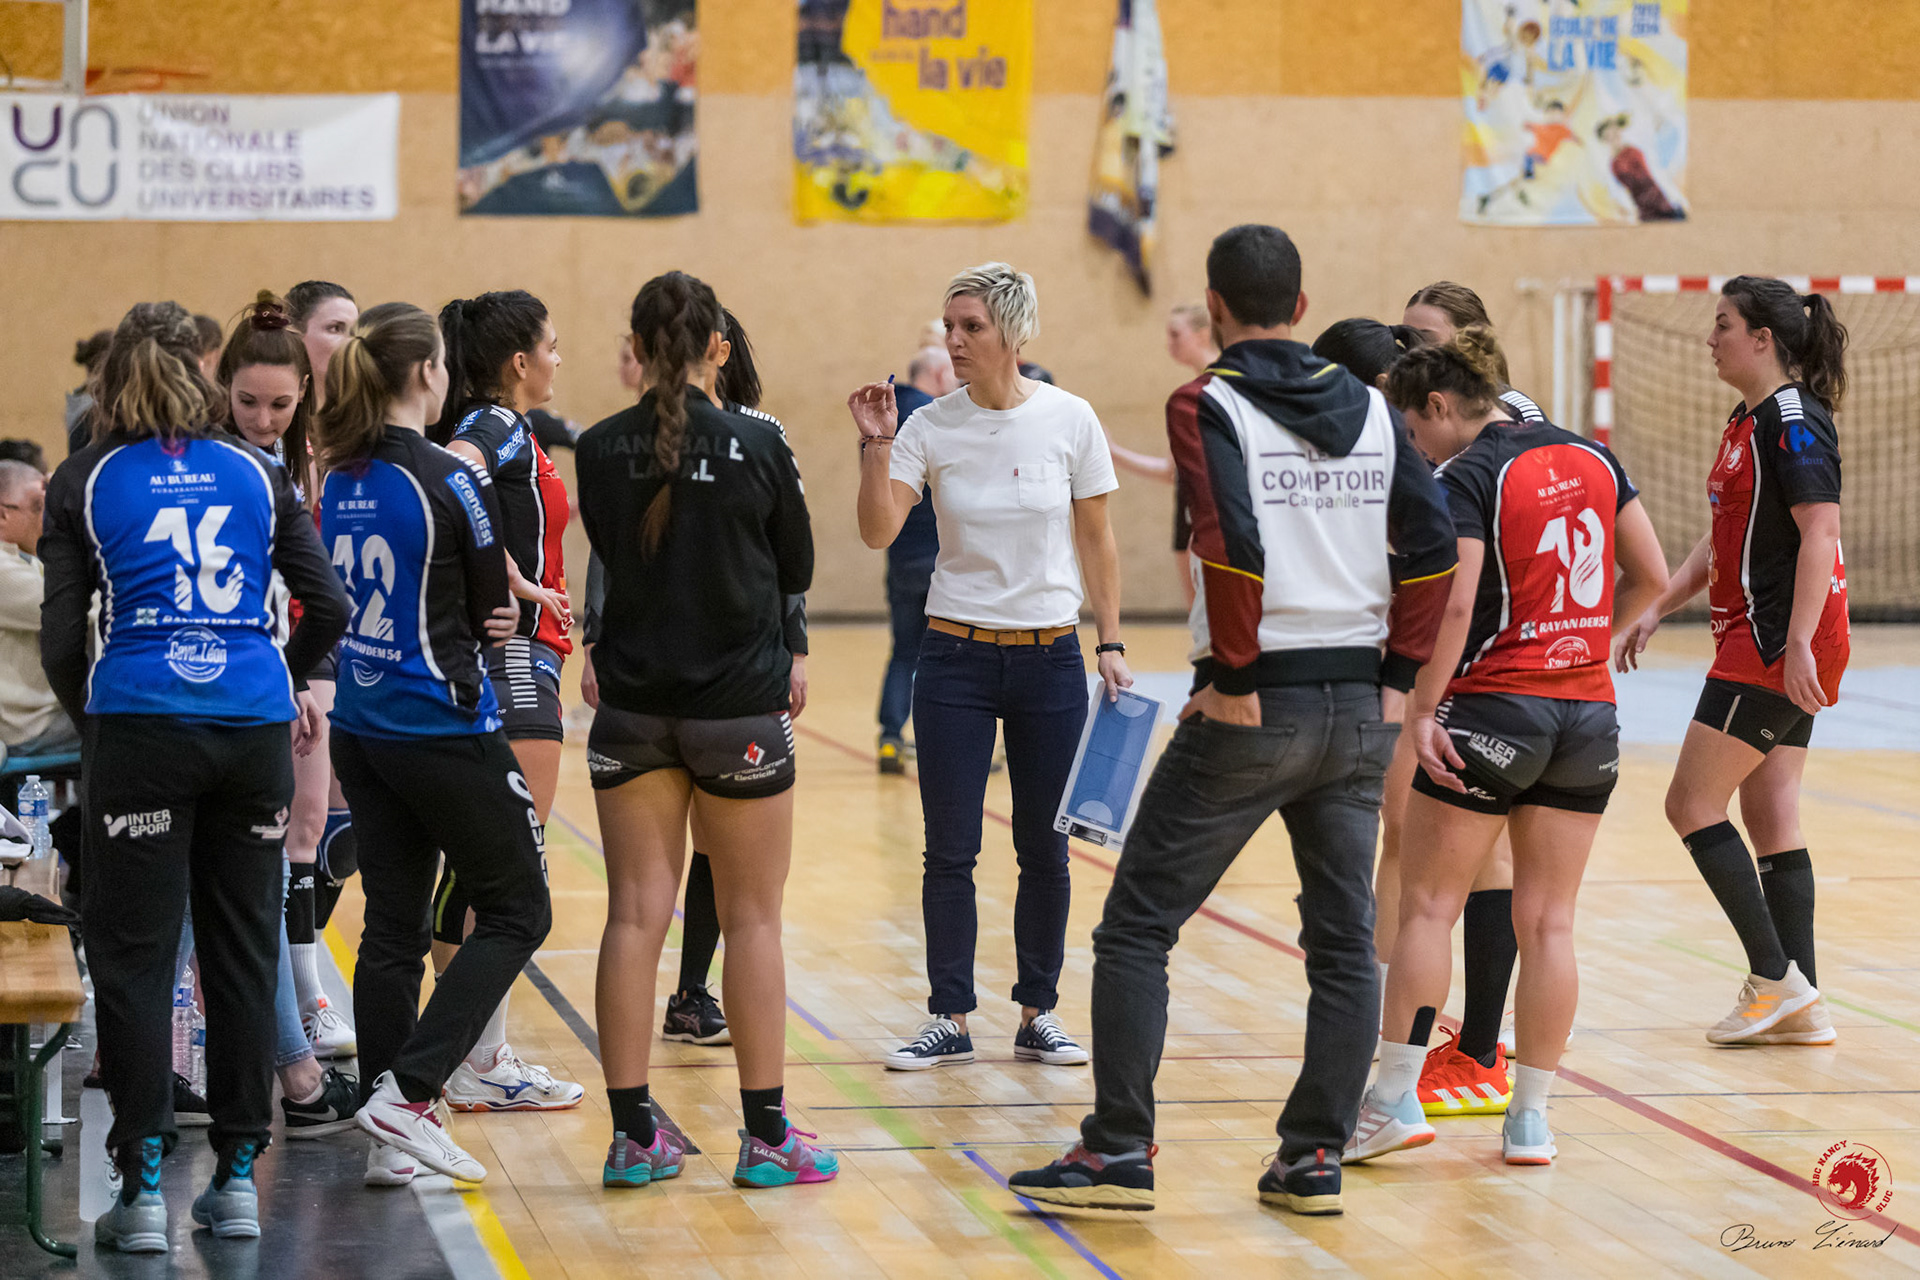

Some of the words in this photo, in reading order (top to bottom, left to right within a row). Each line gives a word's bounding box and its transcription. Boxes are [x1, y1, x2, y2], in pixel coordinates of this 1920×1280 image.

[882, 0, 967, 39] hand
[1548, 41, 1575, 71] LA
[1584, 40, 1617, 70] VIE
[918, 46, 949, 90] la
[956, 46, 1007, 90] vie
[137, 102, 231, 125] UNION
[139, 130, 302, 153] NATIONALE
[138, 160, 196, 182] DES
[204, 160, 306, 182] CLUBS
[137, 186, 377, 210] UNIVERSITAIRES
[150, 475, 166, 486] AU
[167, 473, 216, 485] BUREAU
[1262, 470, 1385, 491] COMPTOIR
[454, 471, 495, 546] GrandEst
[143, 505, 245, 614] 16
[1535, 507, 1605, 613] 18
[332, 534, 396, 642] 12
[387, 649, 402, 662] 54
[1467, 740, 1512, 769] SPORT
[1471, 732, 1517, 760] INTER
[127, 808, 171, 826] INTER
[129, 820, 172, 837] SPORT
[752, 1146, 789, 1167] SALMING
